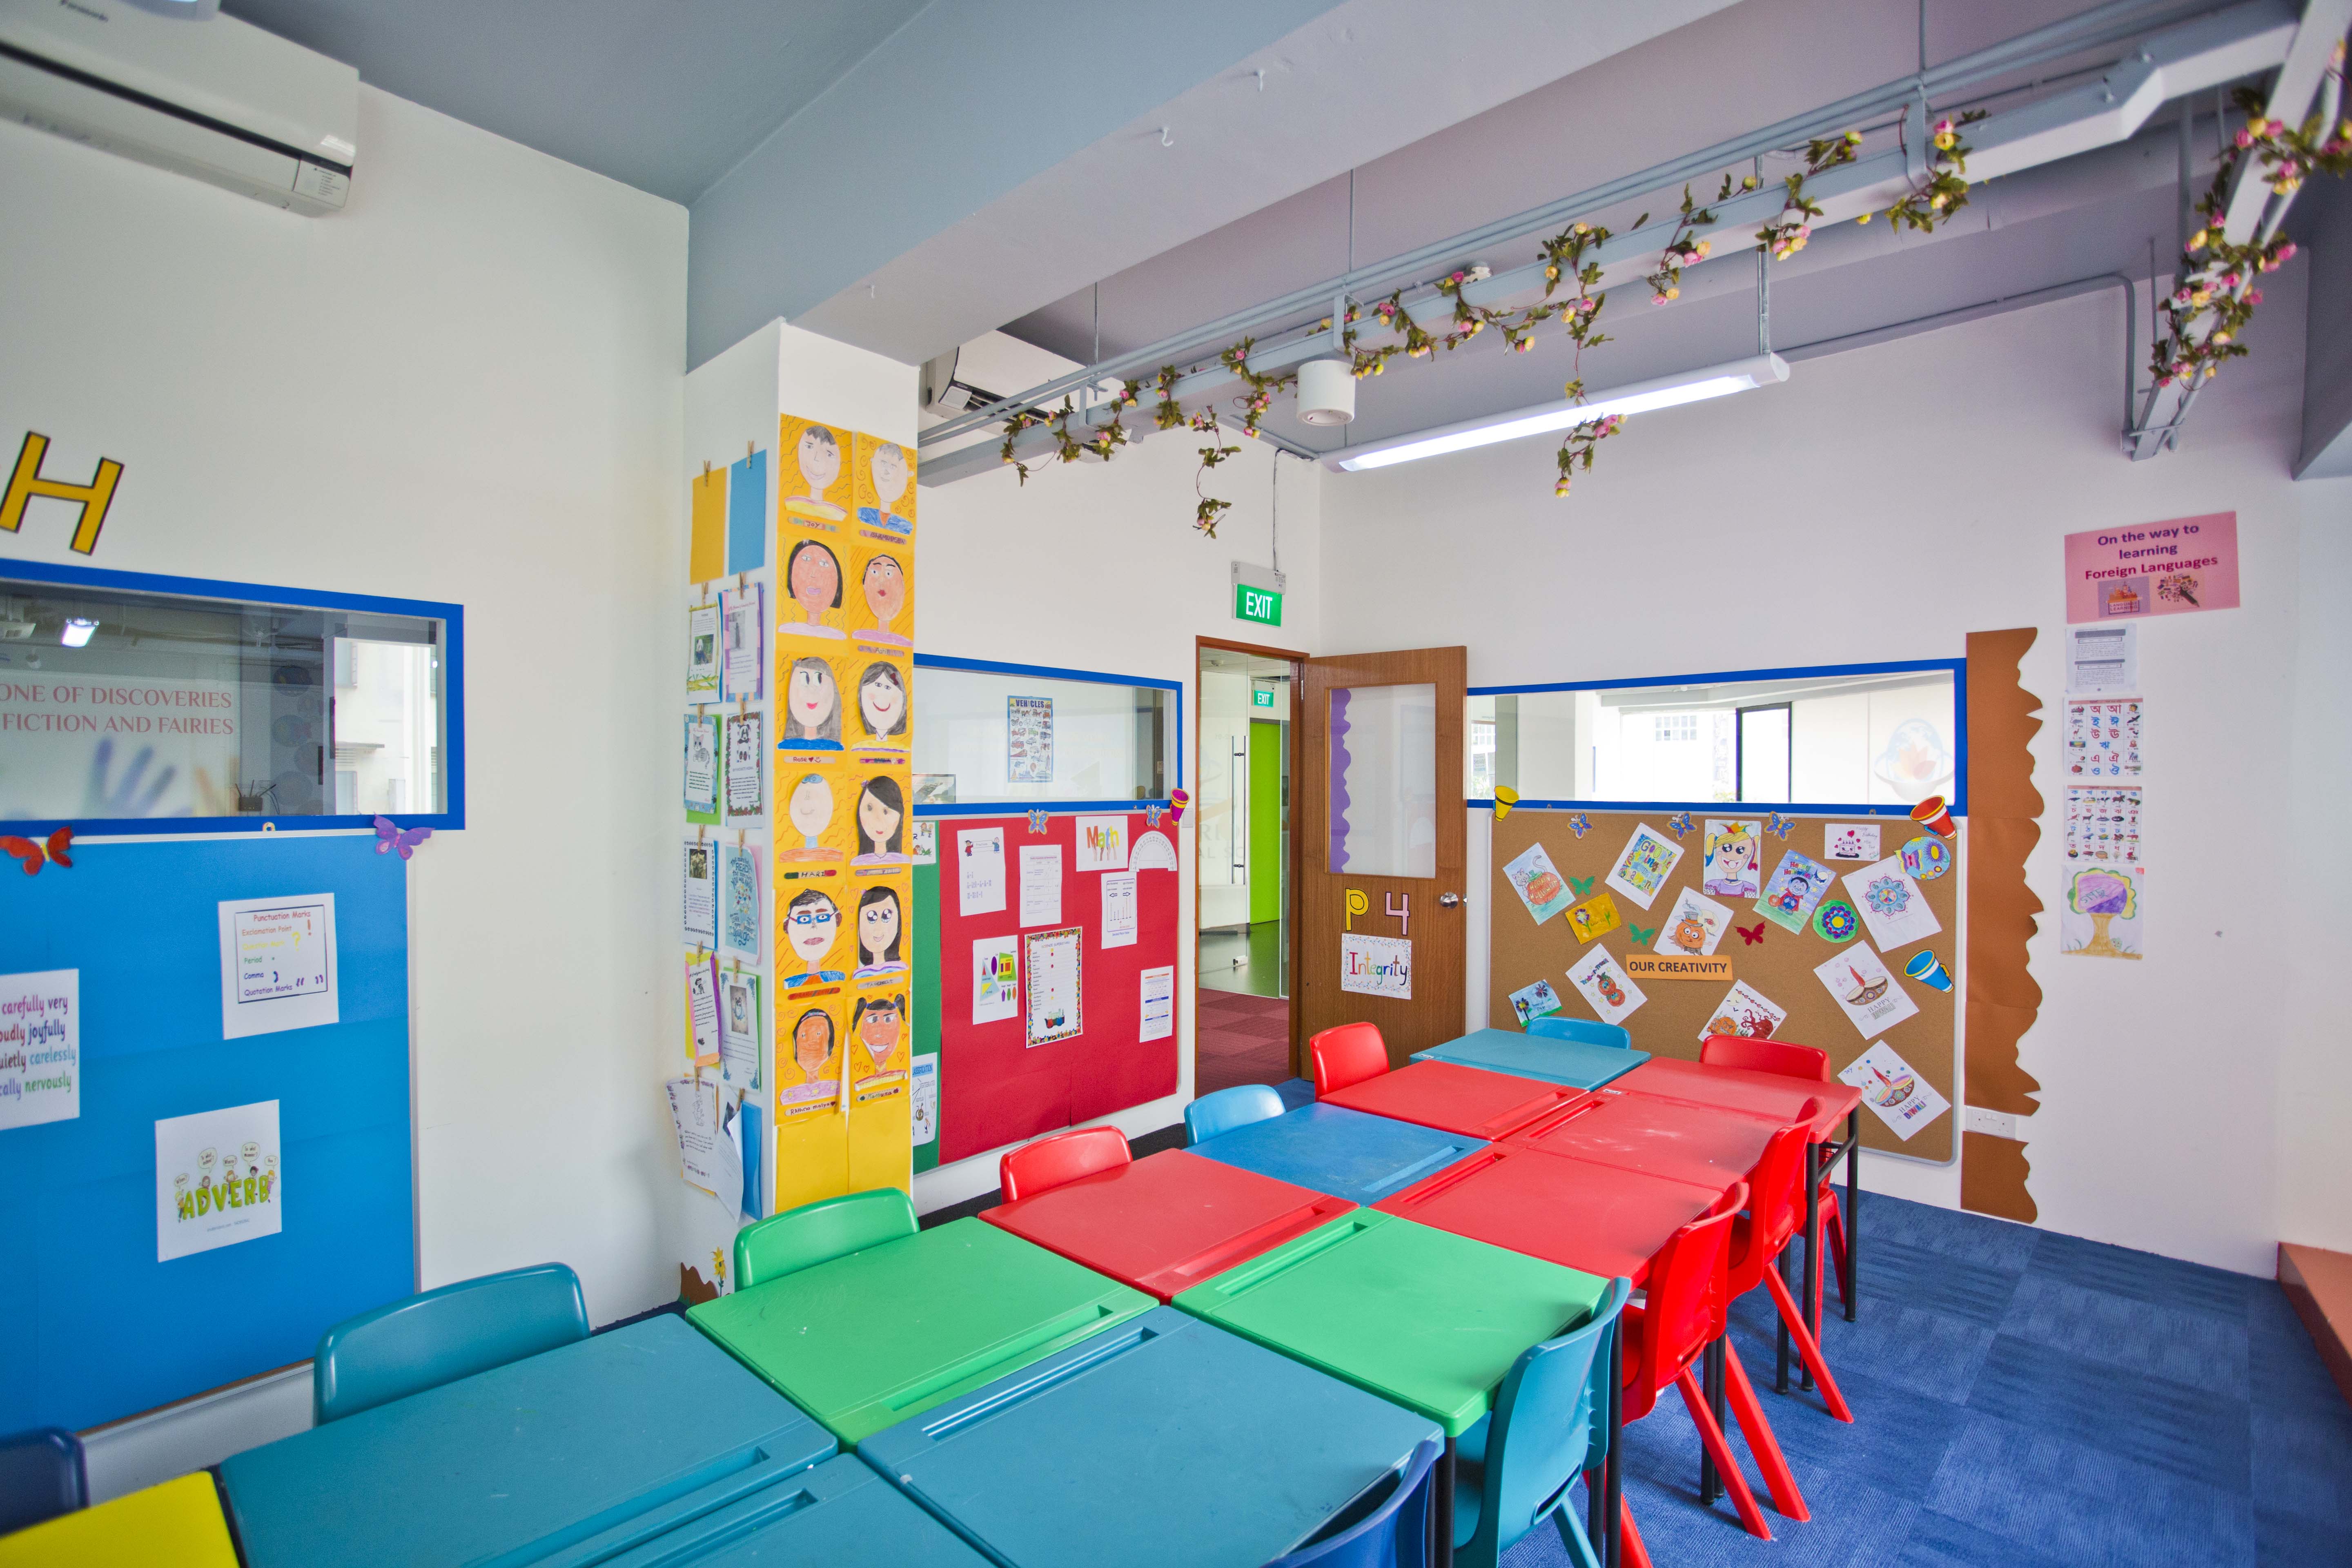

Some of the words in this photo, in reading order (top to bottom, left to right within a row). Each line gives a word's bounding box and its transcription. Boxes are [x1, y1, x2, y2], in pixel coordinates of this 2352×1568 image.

[0, 430, 125, 556] H
[2098, 535, 2118, 546] On
[2121, 531, 2145, 543] the
[2149, 527, 2179, 539] way
[2183, 524, 2200, 534] to
[2119, 545, 2178, 559] learning
[2085, 566, 2136, 580] Foreign
[2141, 556, 2218, 574] Languages
[1246, 592, 1273, 619] EXIT
[53, 686, 84, 703] OF
[91, 687, 232, 708] DISCOVERIES
[1258, 693, 1270, 705] EXIT
[3, 713, 97, 732] FICTION
[104, 715, 151, 733] AND
[158, 717, 234, 735] FAIRIES
[1086, 825, 1119, 849] Math
[1641, 840, 1668, 862] GOOD
[254, 912, 290, 922] Punctuation
[292, 910, 310, 919] Marks
[1345, 888, 1370, 931] P
[1385, 891, 1410, 935] 4
[242, 927, 276, 936] Exclamation
[1349, 951, 1408, 986] Integrity
[1629, 961, 1655, 972] OUR
[1658, 962, 1727, 973] CREATIVITY
[244, 987, 273, 996] Quotation
[2, 995, 45, 1019] carefully
[48, 997, 68, 1015] very
[1867, 997, 1890, 1013] HAPPY
[28, 1019, 65, 1045] joyfully
[29, 1044, 76, 1066] carelessly
[24, 1070, 71, 1093] nervously
[1899, 1095, 1920, 1113] HAPPY
[1903, 1100, 1927, 1119] DIWALI
[183, 1175, 270, 1220] ADVERB
